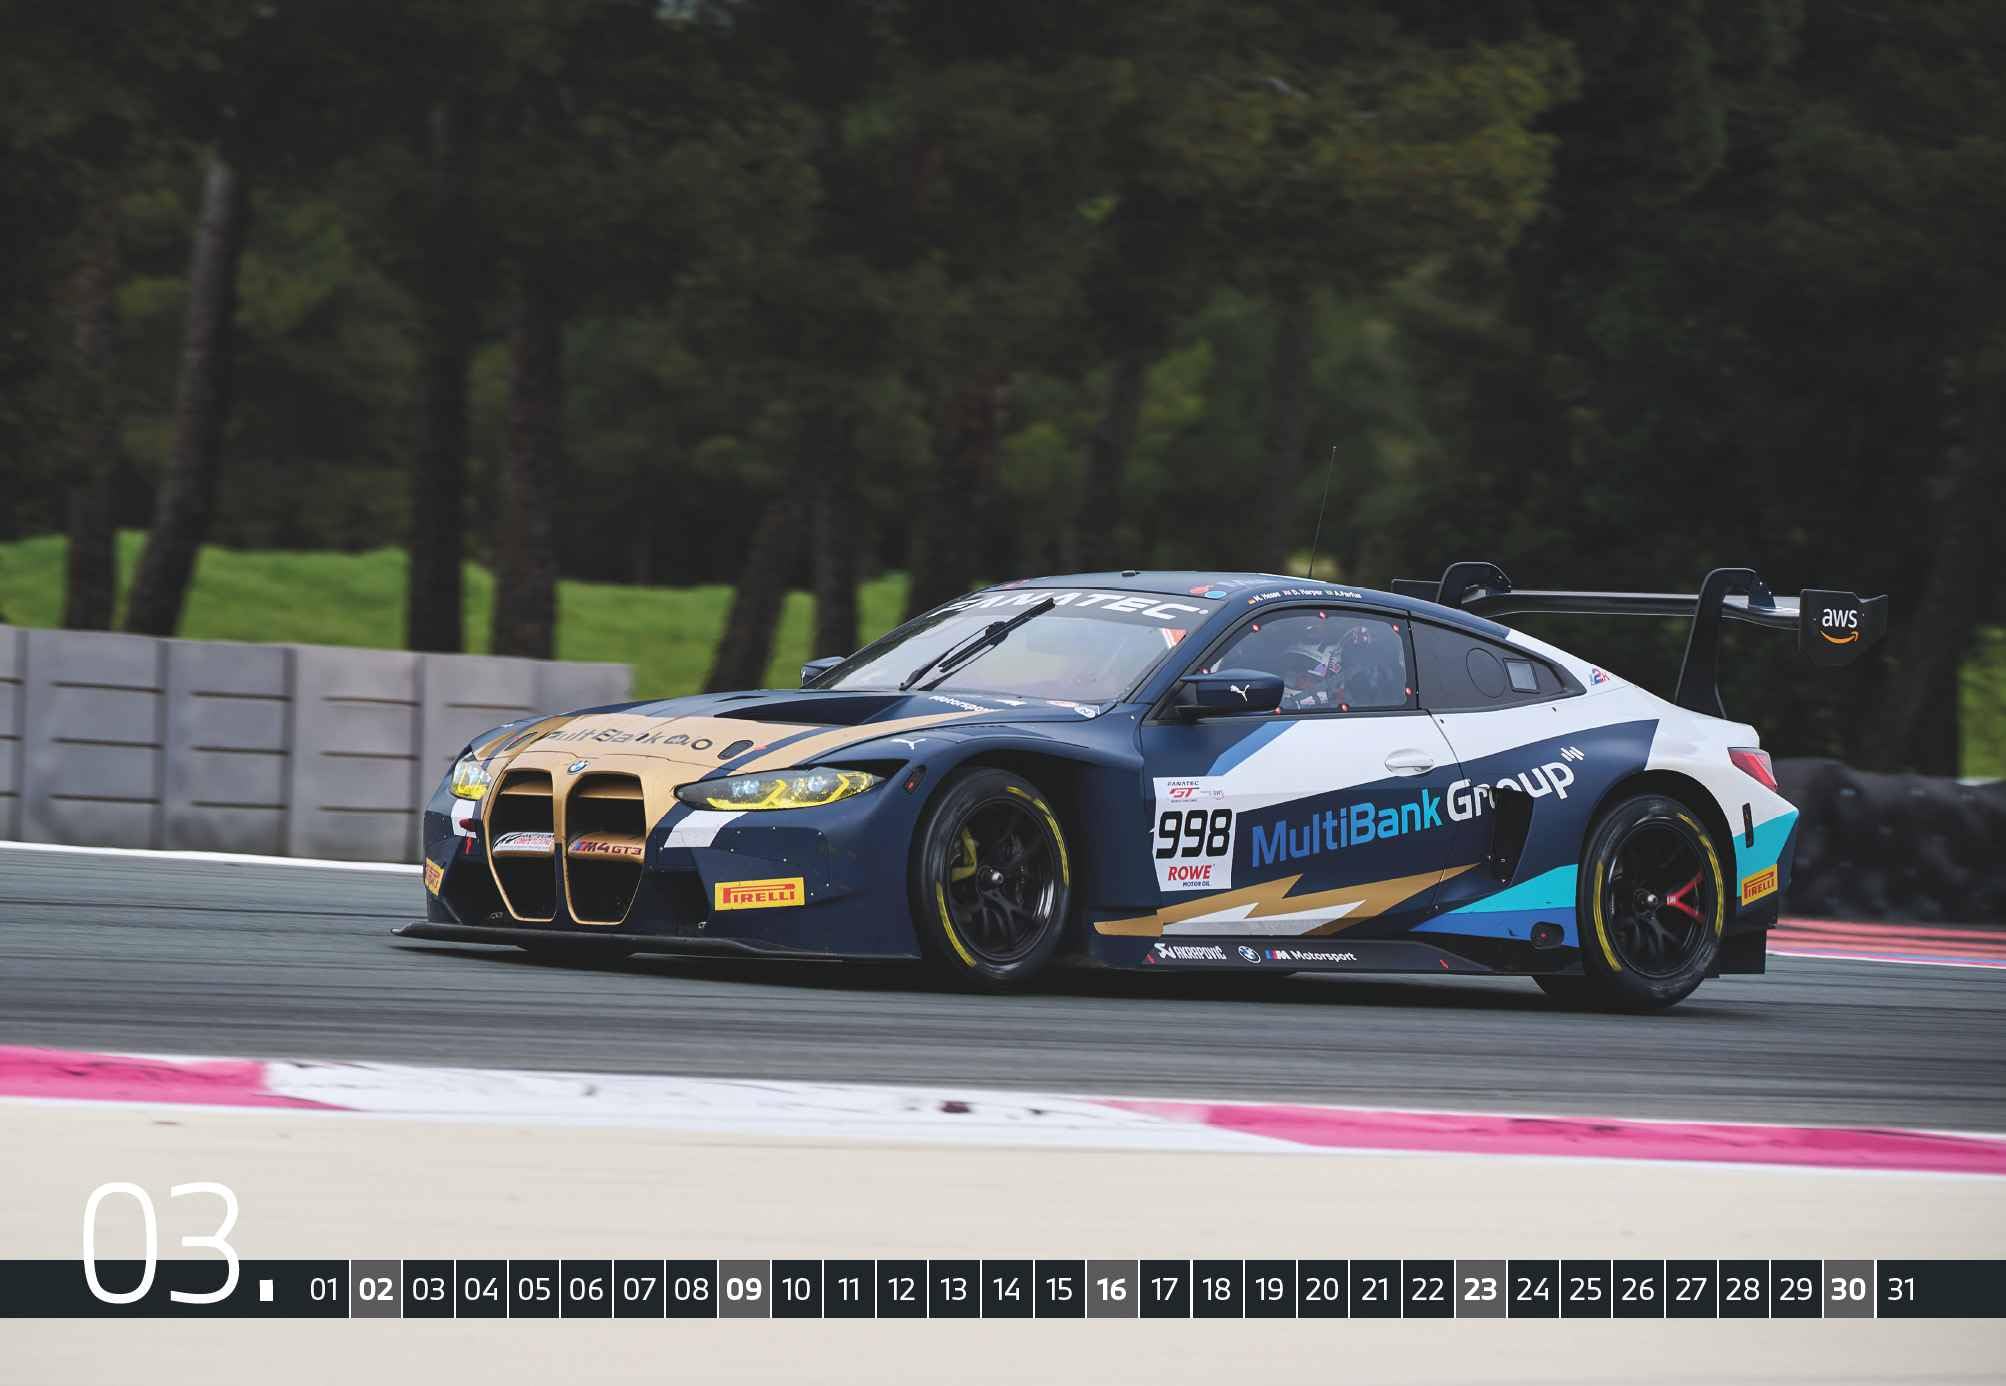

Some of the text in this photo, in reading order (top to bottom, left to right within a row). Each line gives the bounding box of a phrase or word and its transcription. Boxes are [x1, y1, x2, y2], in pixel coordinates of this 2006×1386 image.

[1822, 608, 1857, 628] aws
[1156, 809, 1232, 859] 998
[1252, 789, 1443, 868] MultiBank
[612, 846, 641, 855] GT3
[1168, 864, 1212, 881] ROWE
[723, 883, 797, 904] PIRELLI
[1744, 871, 1774, 898] PIRELLI
[1290, 950, 1358, 963] Motorsport
